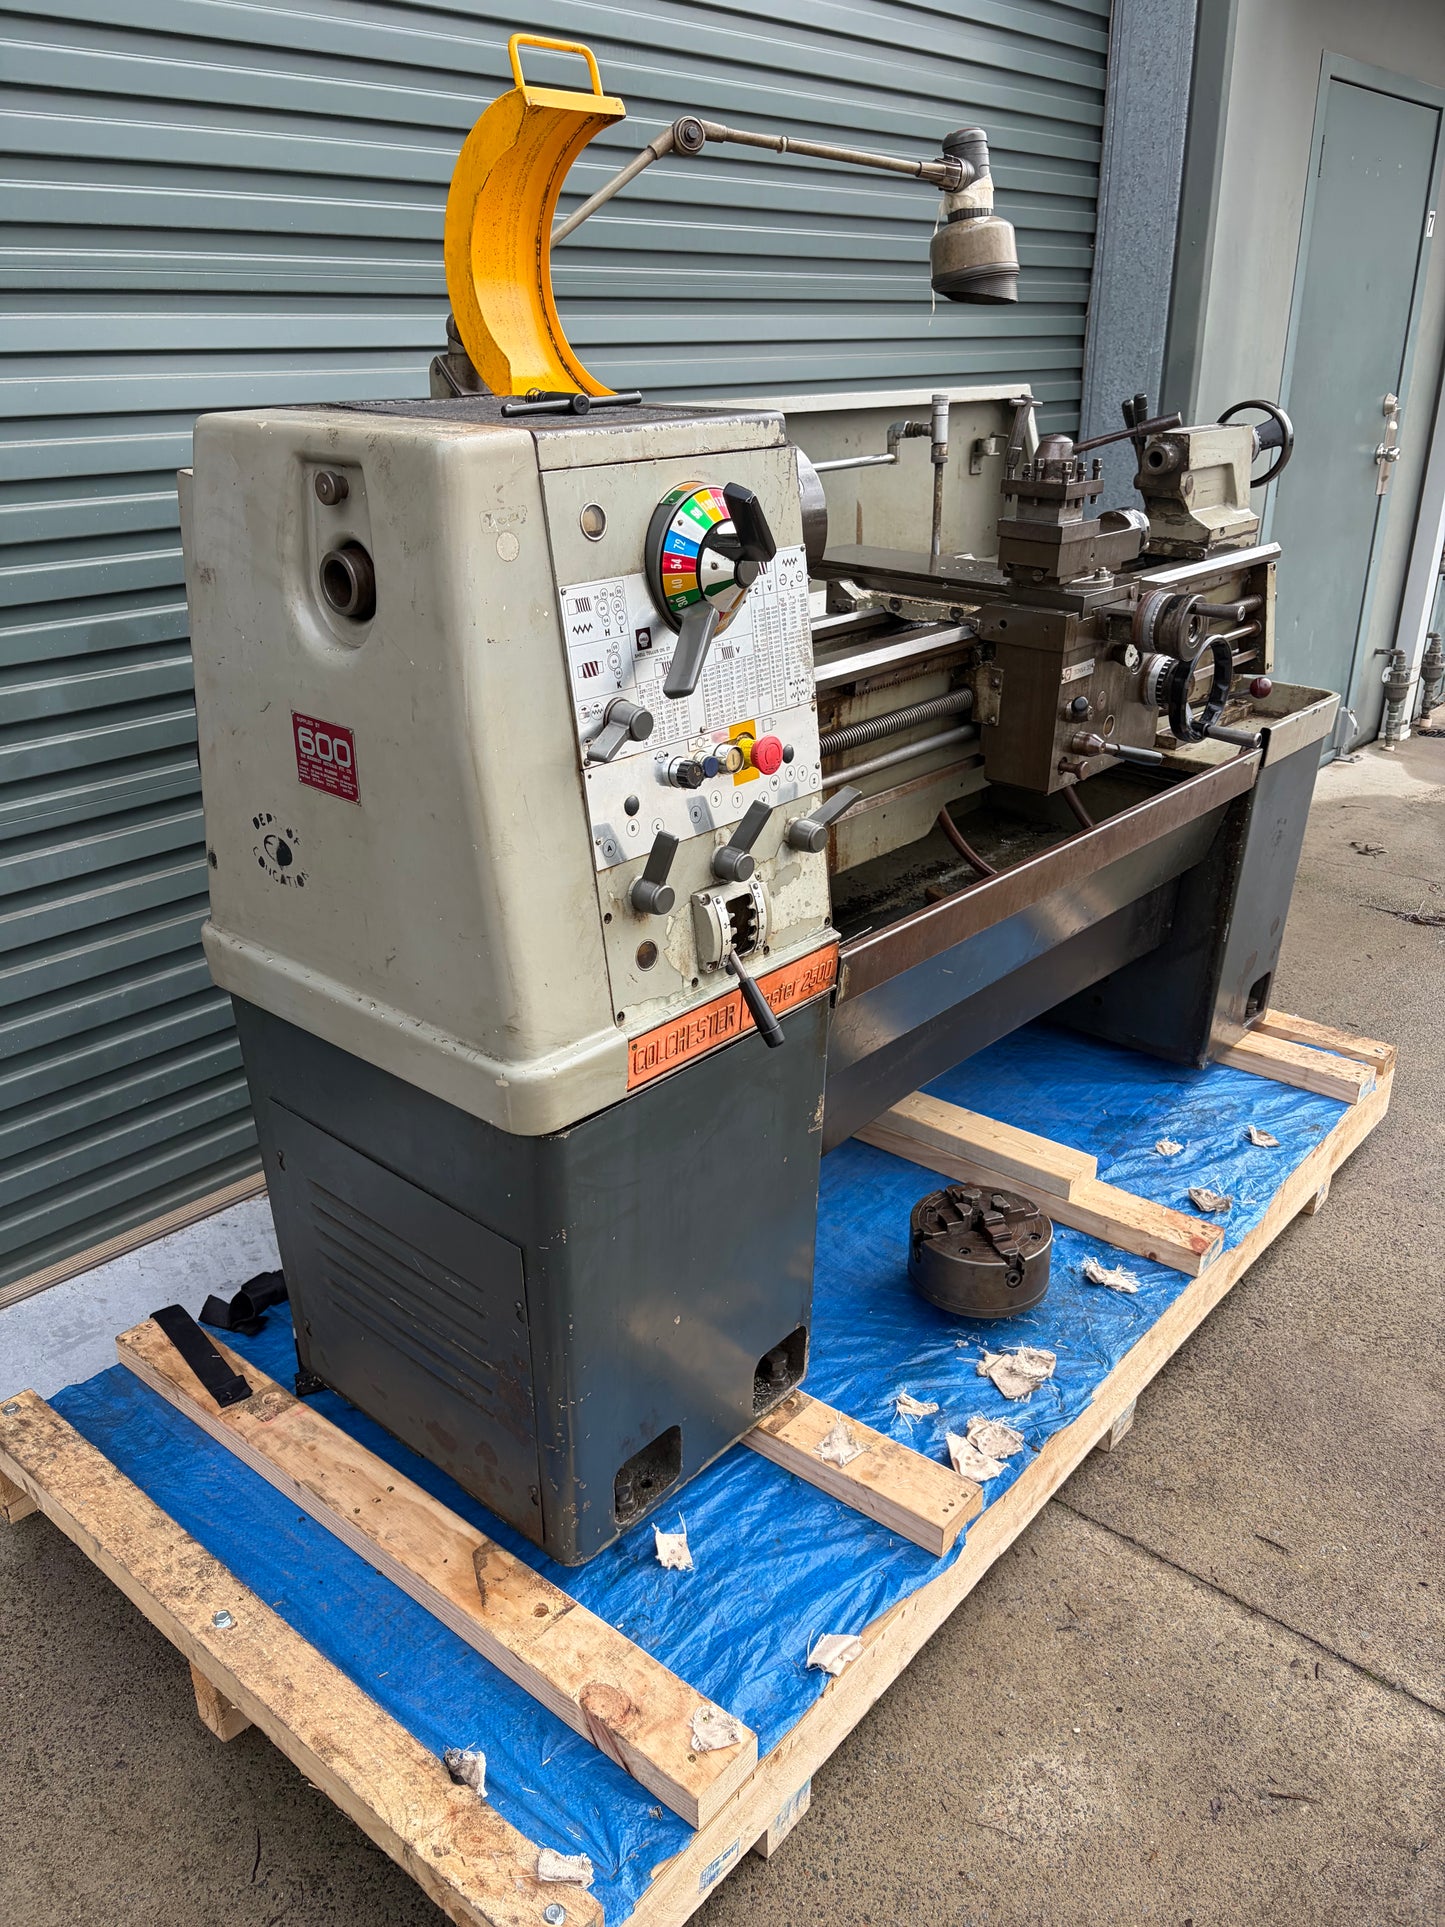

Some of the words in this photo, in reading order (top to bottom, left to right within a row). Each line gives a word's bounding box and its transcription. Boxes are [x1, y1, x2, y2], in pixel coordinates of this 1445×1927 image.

[673, 538, 686, 551] 72
[671, 558, 682, 570] 54
[672, 578, 683, 589] 40
[675, 596, 688, 608] 30
[604, 629, 611, 637] H
[616, 680, 623, 689] K
[297, 725, 352, 768] 600
[771, 779, 778, 787] W
[633, 1001, 737, 1075] COLCHESTER
[801, 959, 834, 992] 2500
